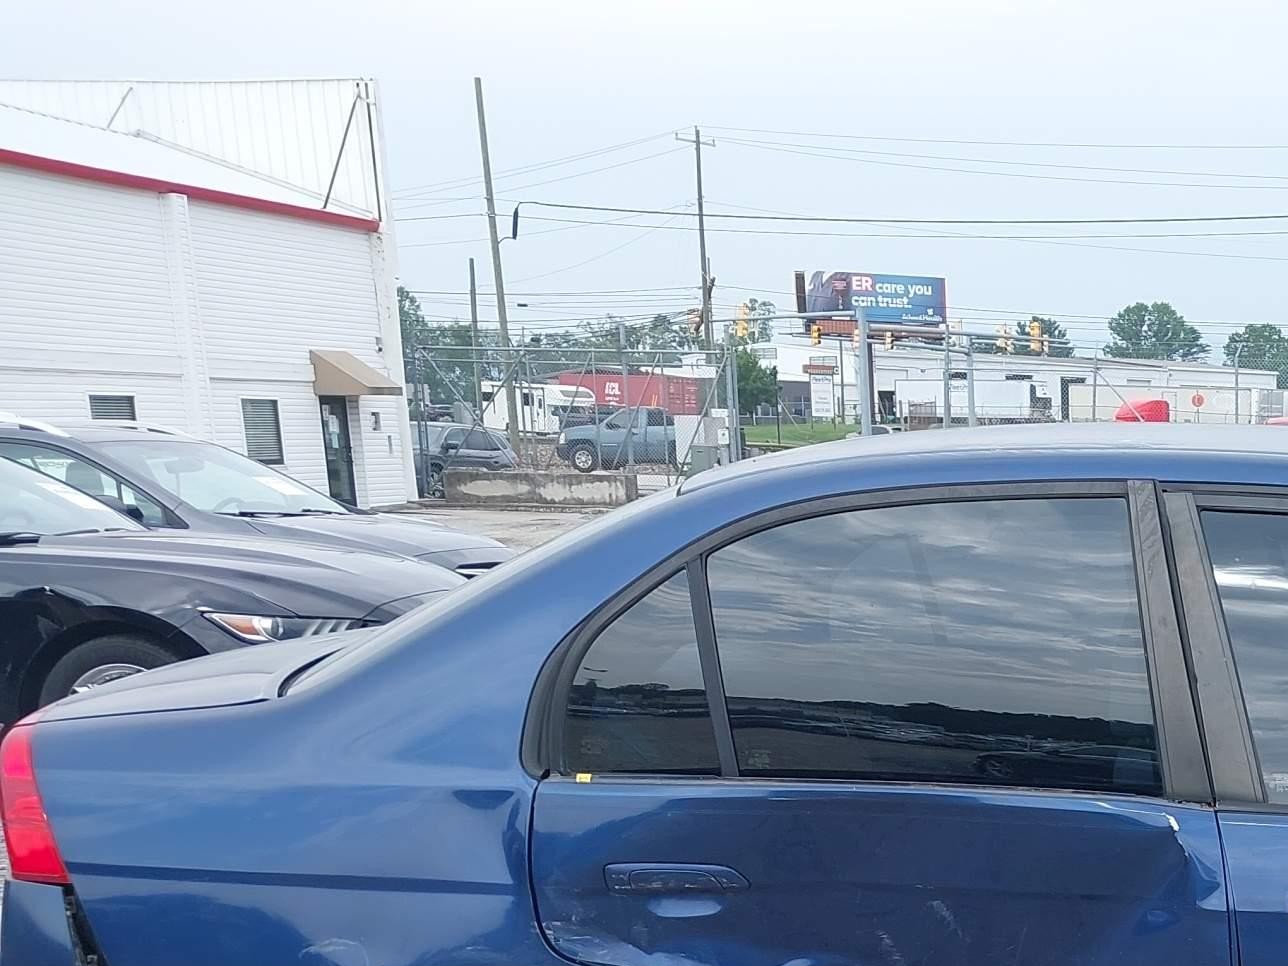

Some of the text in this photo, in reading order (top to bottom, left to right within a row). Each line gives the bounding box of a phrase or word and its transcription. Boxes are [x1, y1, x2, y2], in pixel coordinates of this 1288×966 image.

[852, 276, 873, 291] ER
[875, 282, 905, 294] care
[907, 284, 932, 298] you
[851, 295, 912, 308] can trust.
